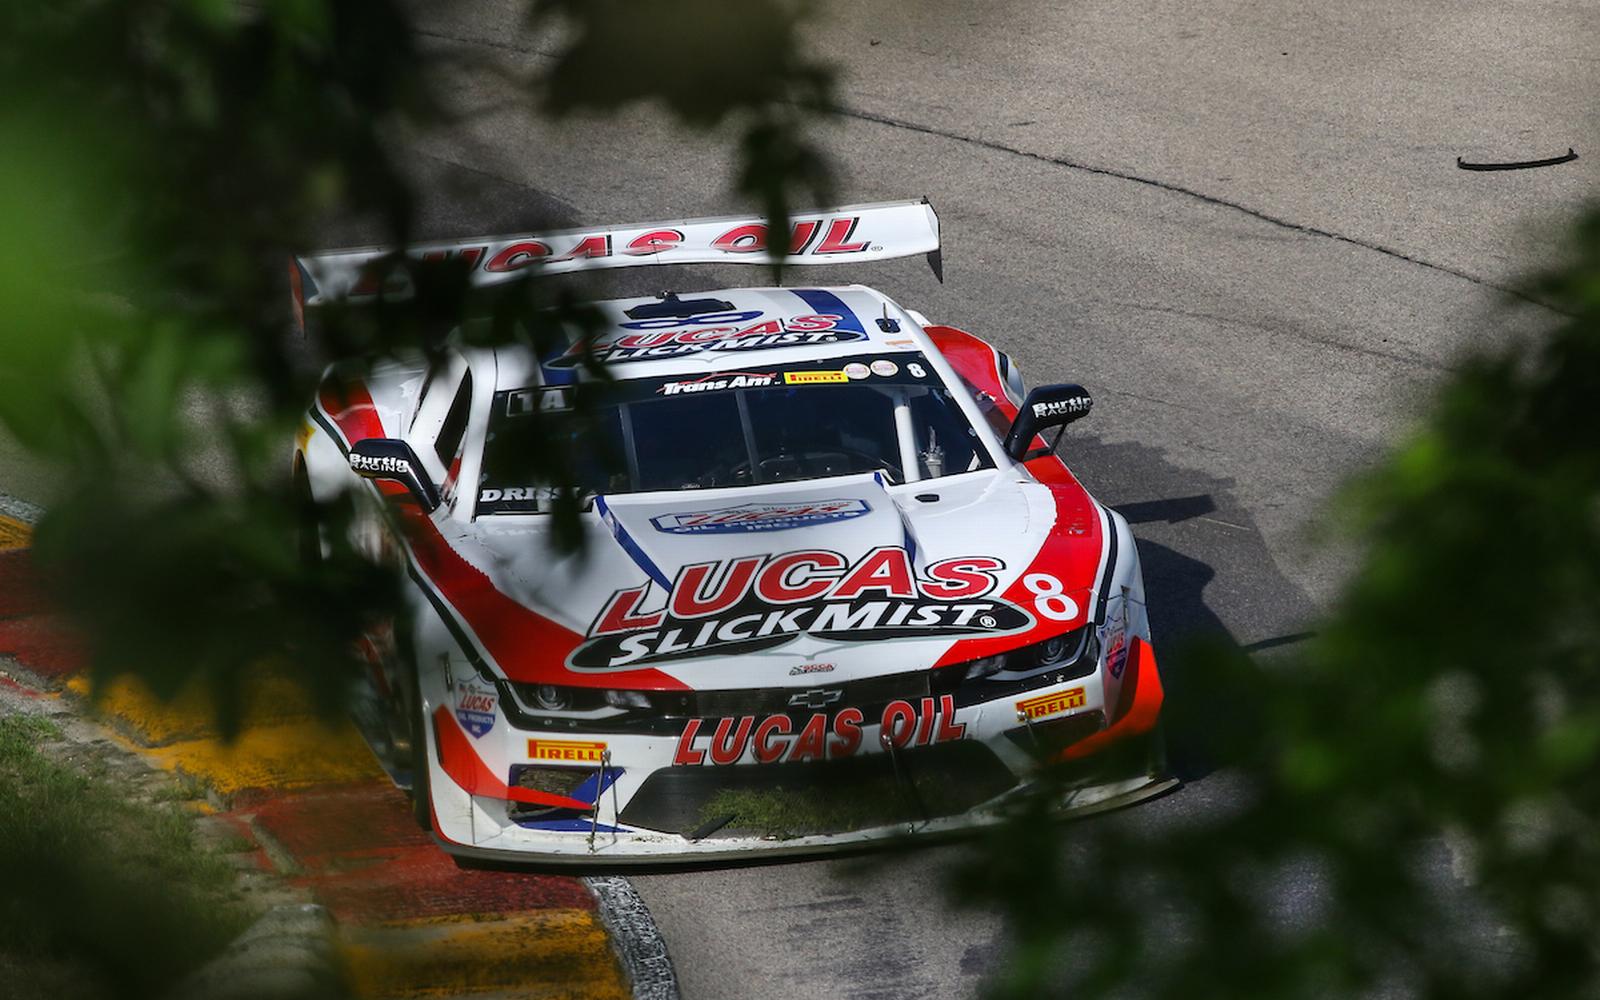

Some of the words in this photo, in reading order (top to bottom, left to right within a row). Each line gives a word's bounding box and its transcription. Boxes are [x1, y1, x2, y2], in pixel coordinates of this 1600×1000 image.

[350, 229, 685, 294] CAS
[710, 216, 871, 255] OIL
[663, 382, 727, 396] Trans
[728, 374, 770, 389] Am
[906, 362, 926, 378] 8
[588, 546, 1006, 636] LUCAS
[1022, 573, 1079, 621] 8
[1016, 687, 1085, 722] PIRELLI
[672, 707, 866, 767] LUCAS
[879, 694, 967, 752] OIL
